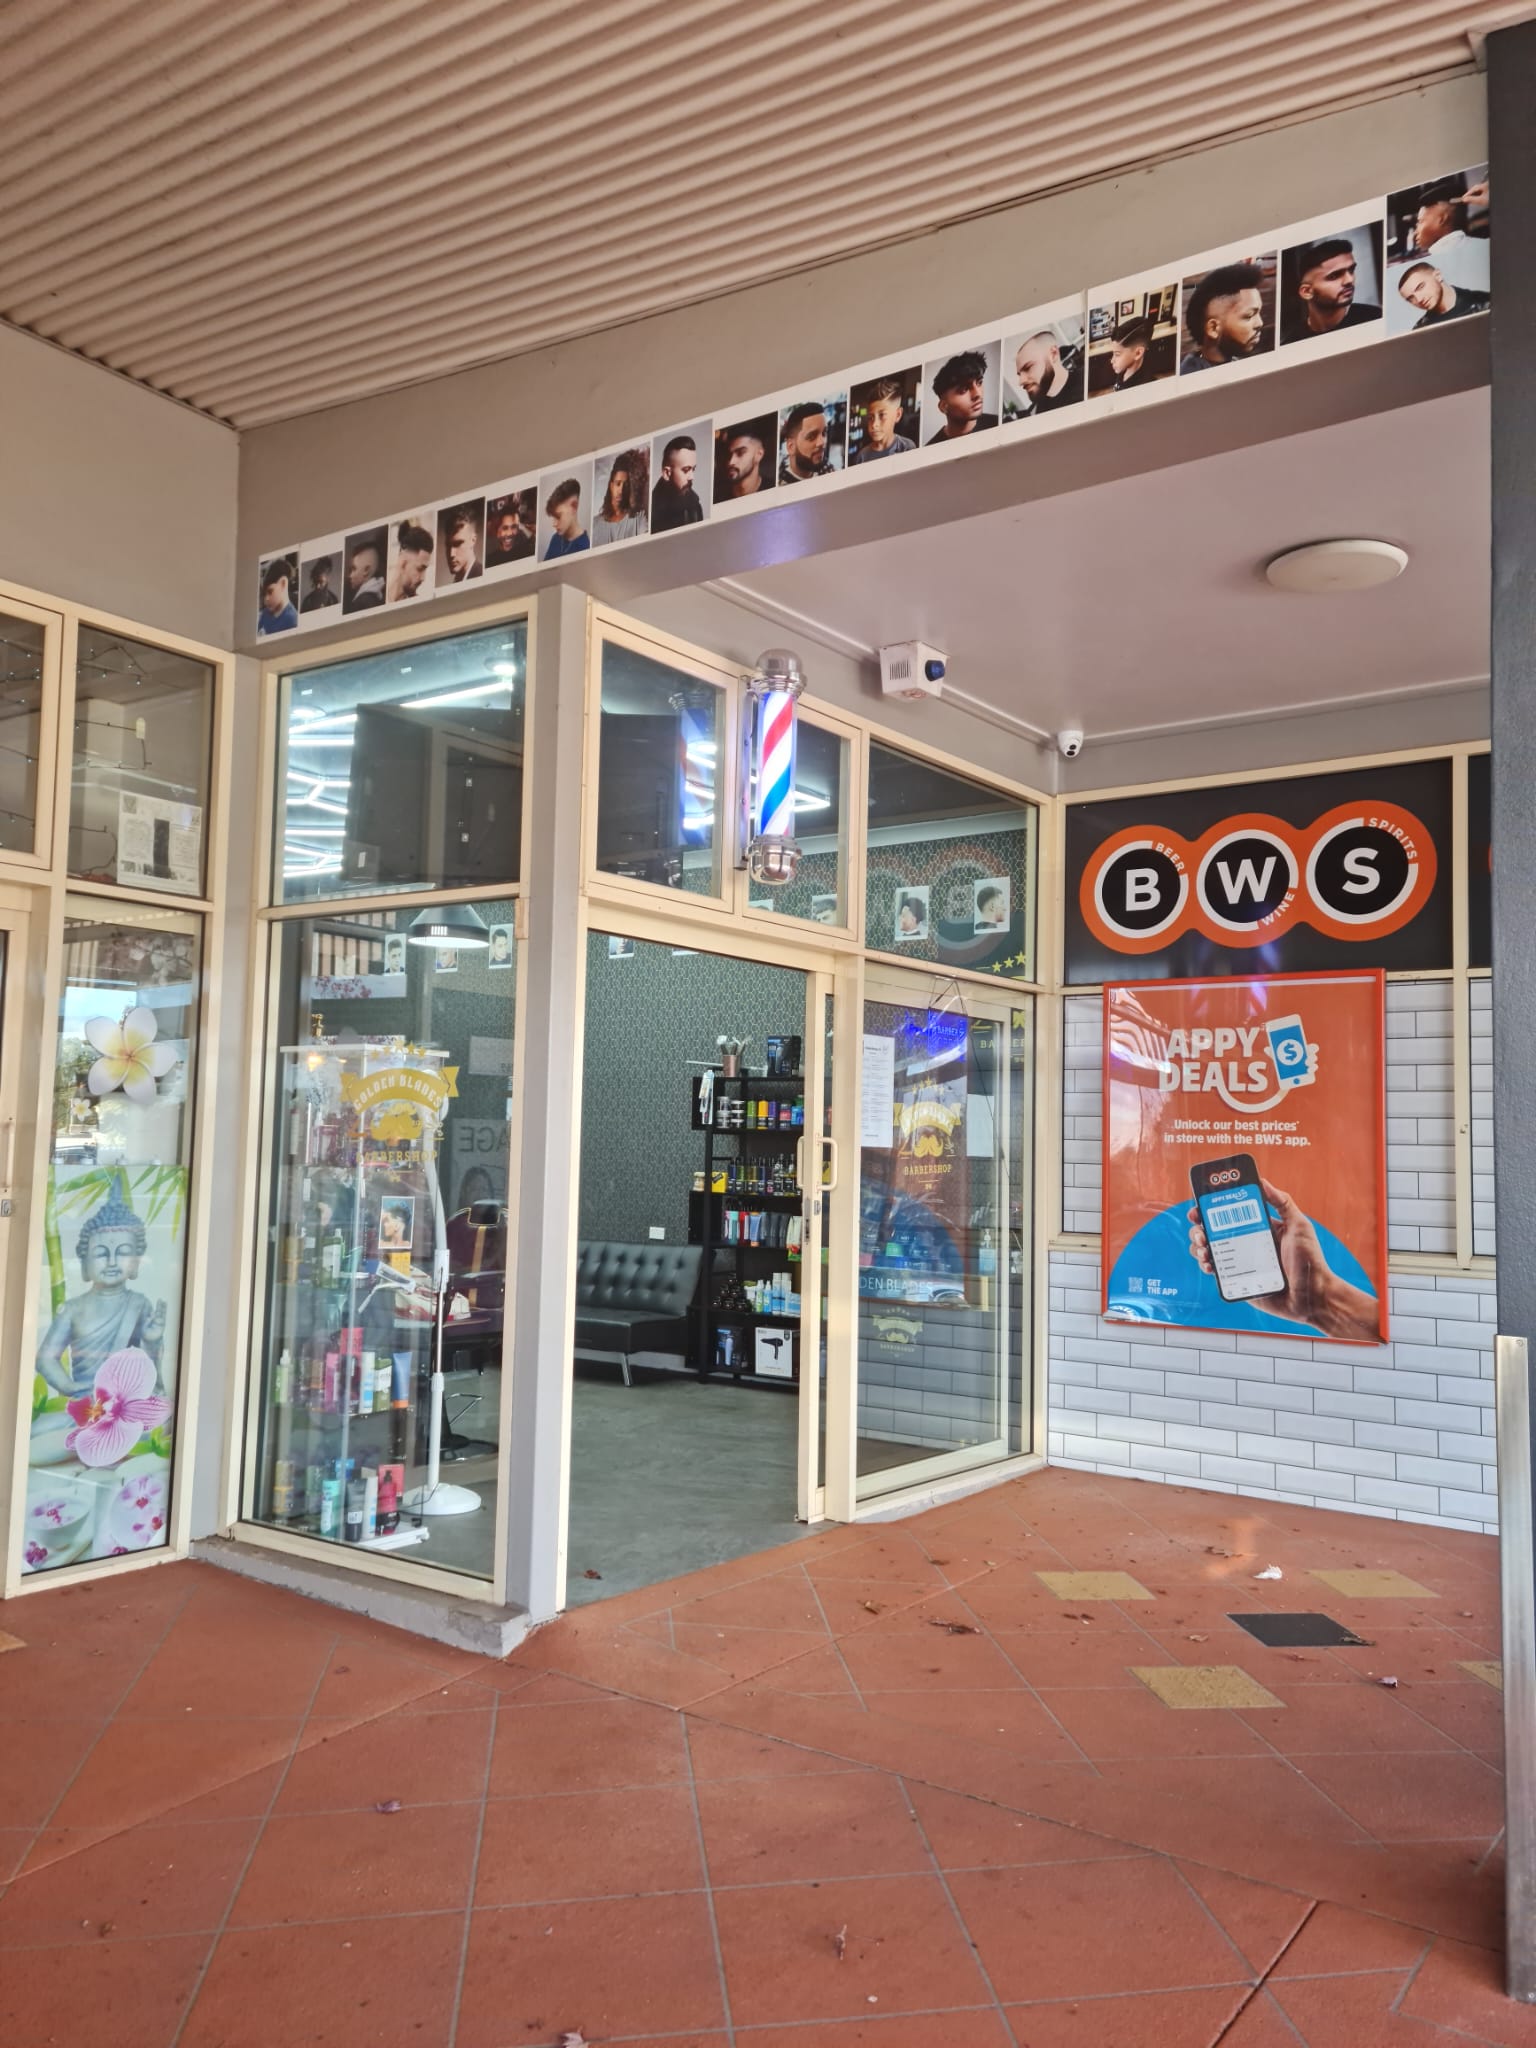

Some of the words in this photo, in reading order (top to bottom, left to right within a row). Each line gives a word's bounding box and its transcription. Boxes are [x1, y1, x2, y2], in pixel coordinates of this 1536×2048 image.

[1368, 817, 1418, 860] SPIRITS
[1155, 842, 1185, 873] BEER
[1261, 892, 1295, 927] WINE
[1167, 1027, 1260, 1059] APPY
[1159, 1061, 1268, 1092] DEALS
[399, 1074, 443, 1109] BLADES
[1174, 1119, 1210, 1130] Unlock
[1213, 1121, 1232, 1131] our
[1234, 1120, 1259, 1131] best
[1164, 1132, 1174, 1143] in
[1176, 1133, 1204, 1144] store
[1206, 1133, 1232, 1144] with
[1234, 1133, 1253, 1144] the
[1255, 1134, 1282, 1145] BWS
[1284, 1136, 1311, 1147] app.
[355, 1150, 438, 1162] BARBERSHOP
[904, 1163, 953, 1176] BARBERSHOP
[1147, 1279, 1162, 1287] GET
[1147, 1287, 1161, 1295] THE
[1162, 1288, 1178, 1296] APP
